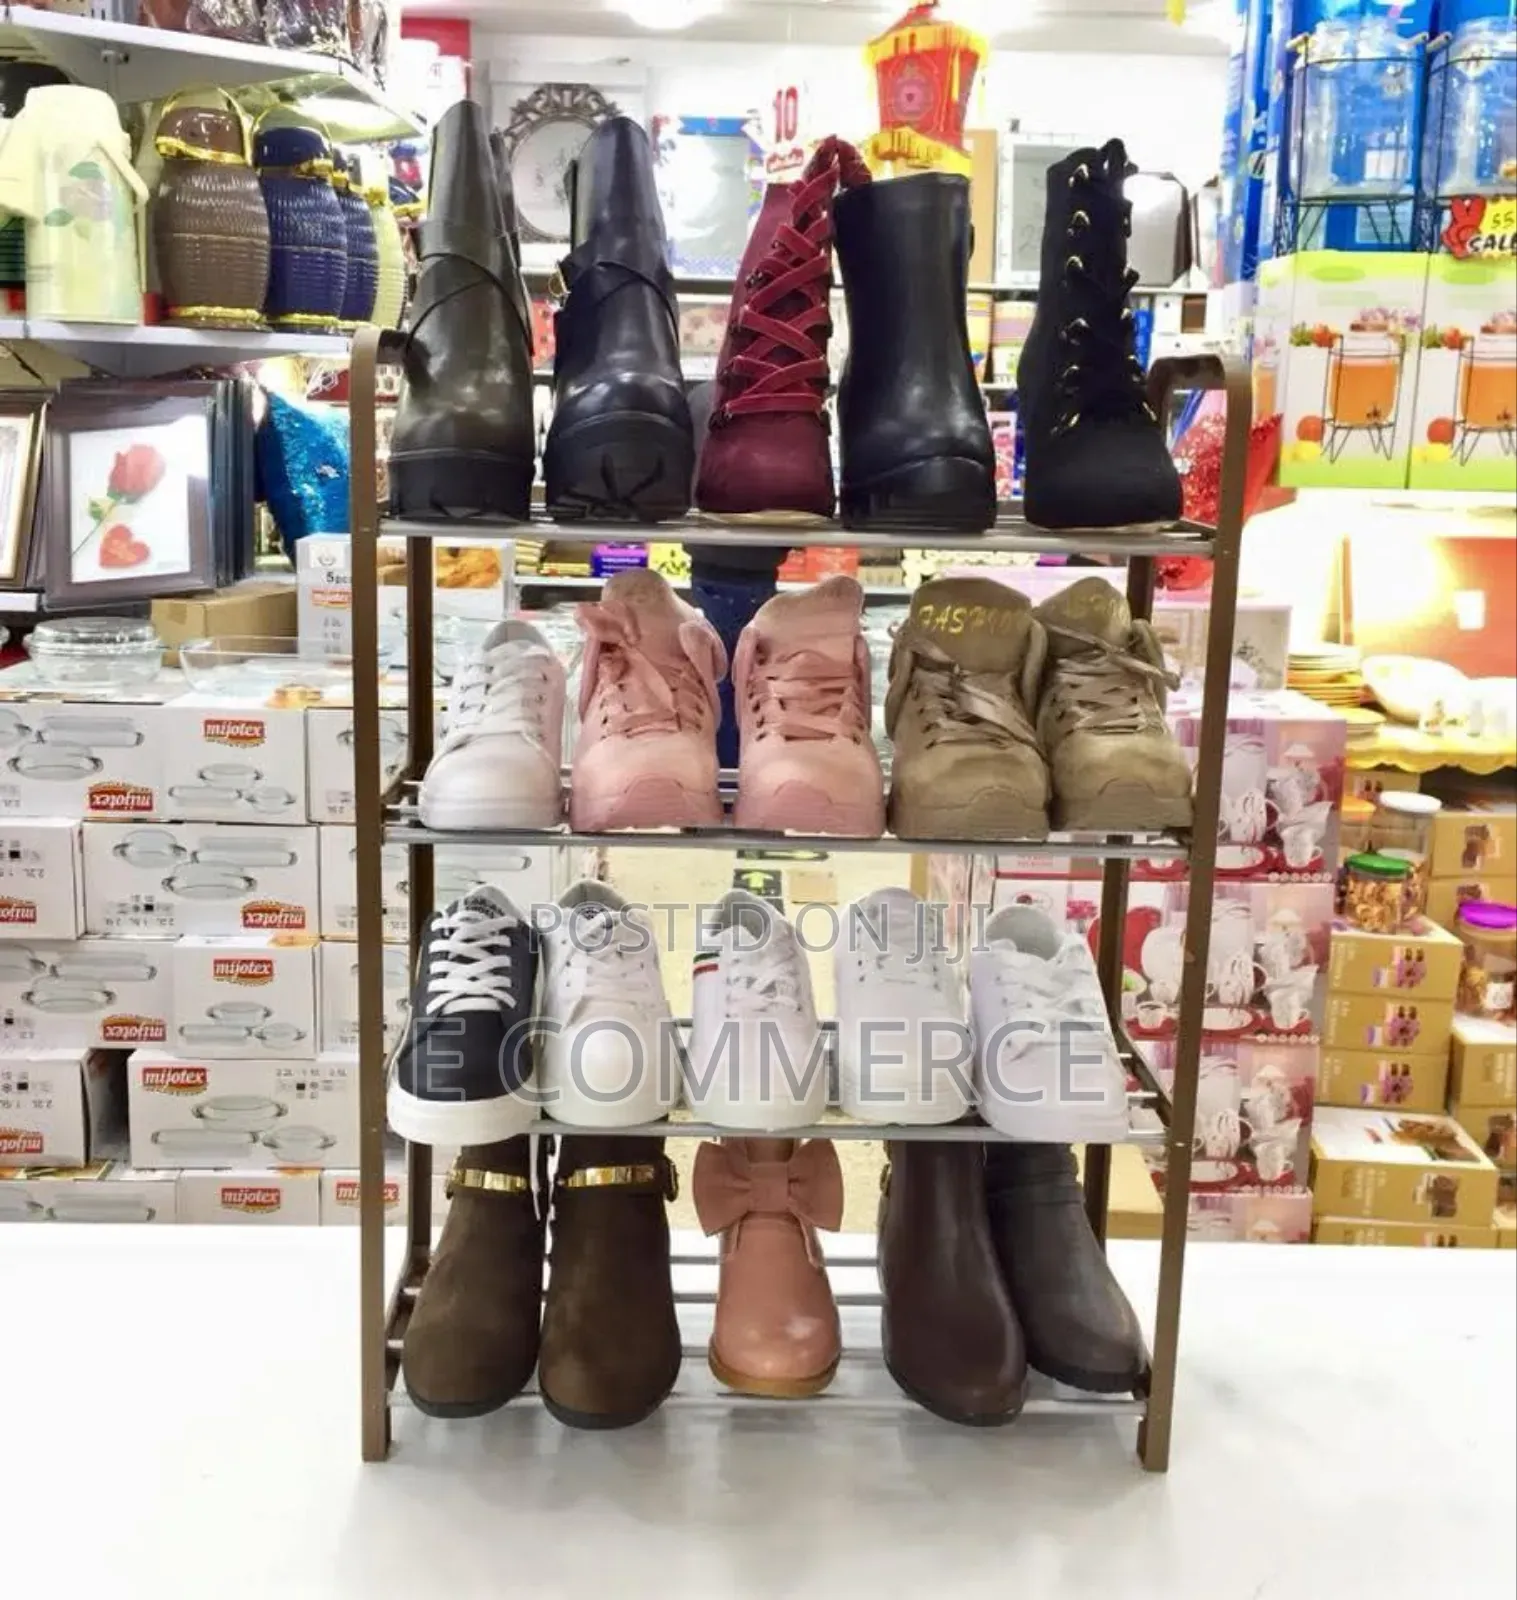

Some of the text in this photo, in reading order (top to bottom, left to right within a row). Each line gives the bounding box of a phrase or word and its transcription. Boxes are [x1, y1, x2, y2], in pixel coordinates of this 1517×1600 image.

[206, 721, 263, 740] mijotex
[91, 792, 151, 811] mijotex
[246, 910, 304, 927] mijotex
[215, 960, 271, 978] mijotex
[105, 1023, 163, 1041] mijotex
[145, 1069, 205, 1089] mijotex
[223, 1190, 279, 1209] mijotex
